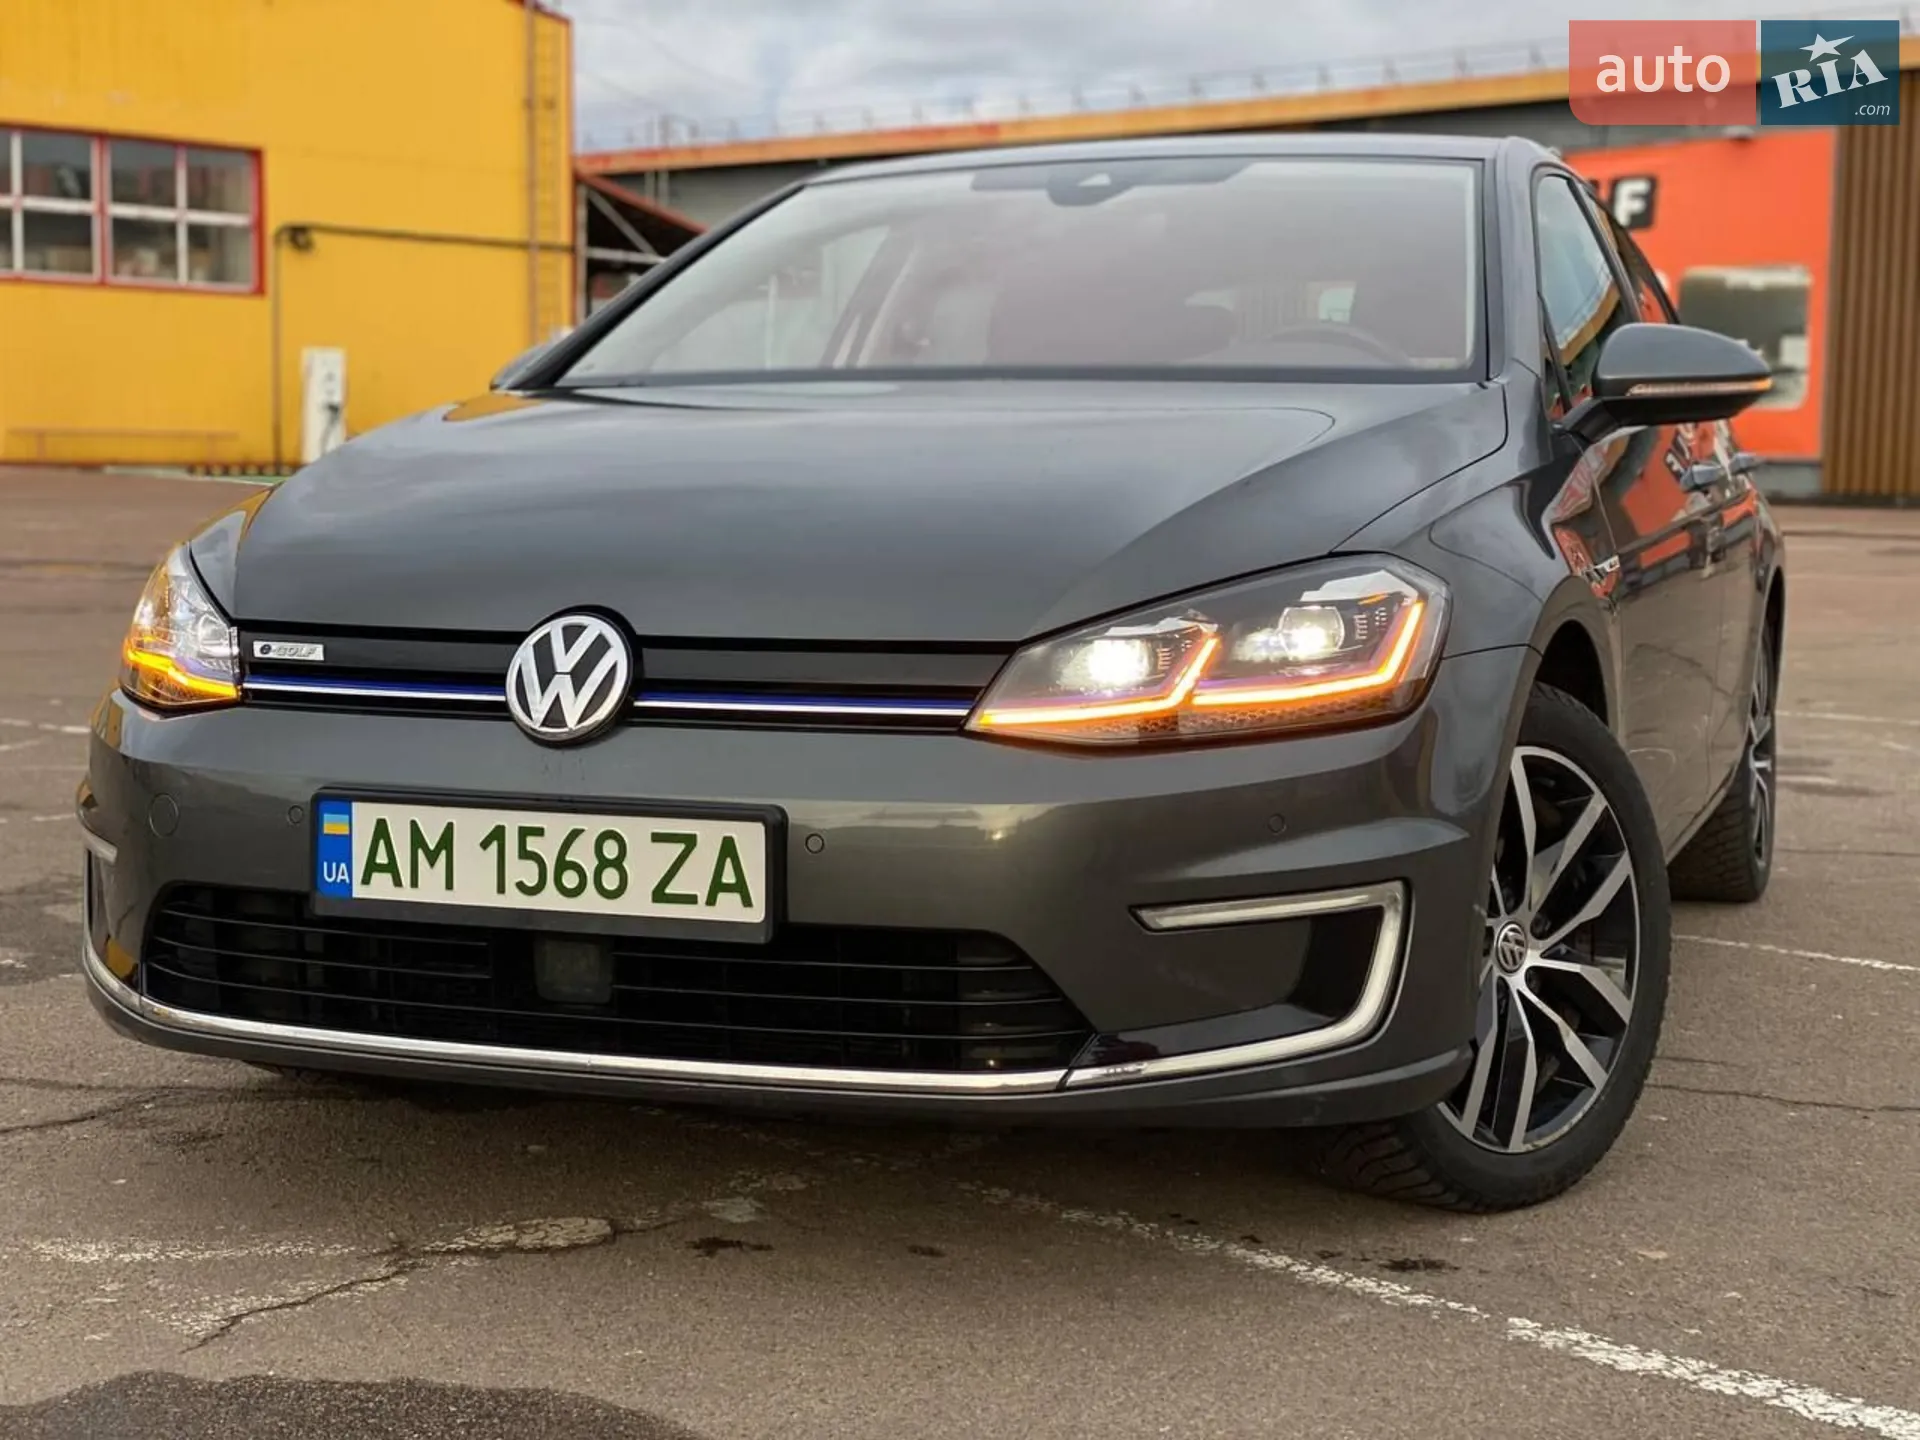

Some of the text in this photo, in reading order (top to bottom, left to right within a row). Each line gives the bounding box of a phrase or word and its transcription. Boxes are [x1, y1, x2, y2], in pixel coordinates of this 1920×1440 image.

[511, 617, 627, 735] VW
[323, 861, 350, 884] UA
[360, 817, 754, 908] AM 1568 ZA
